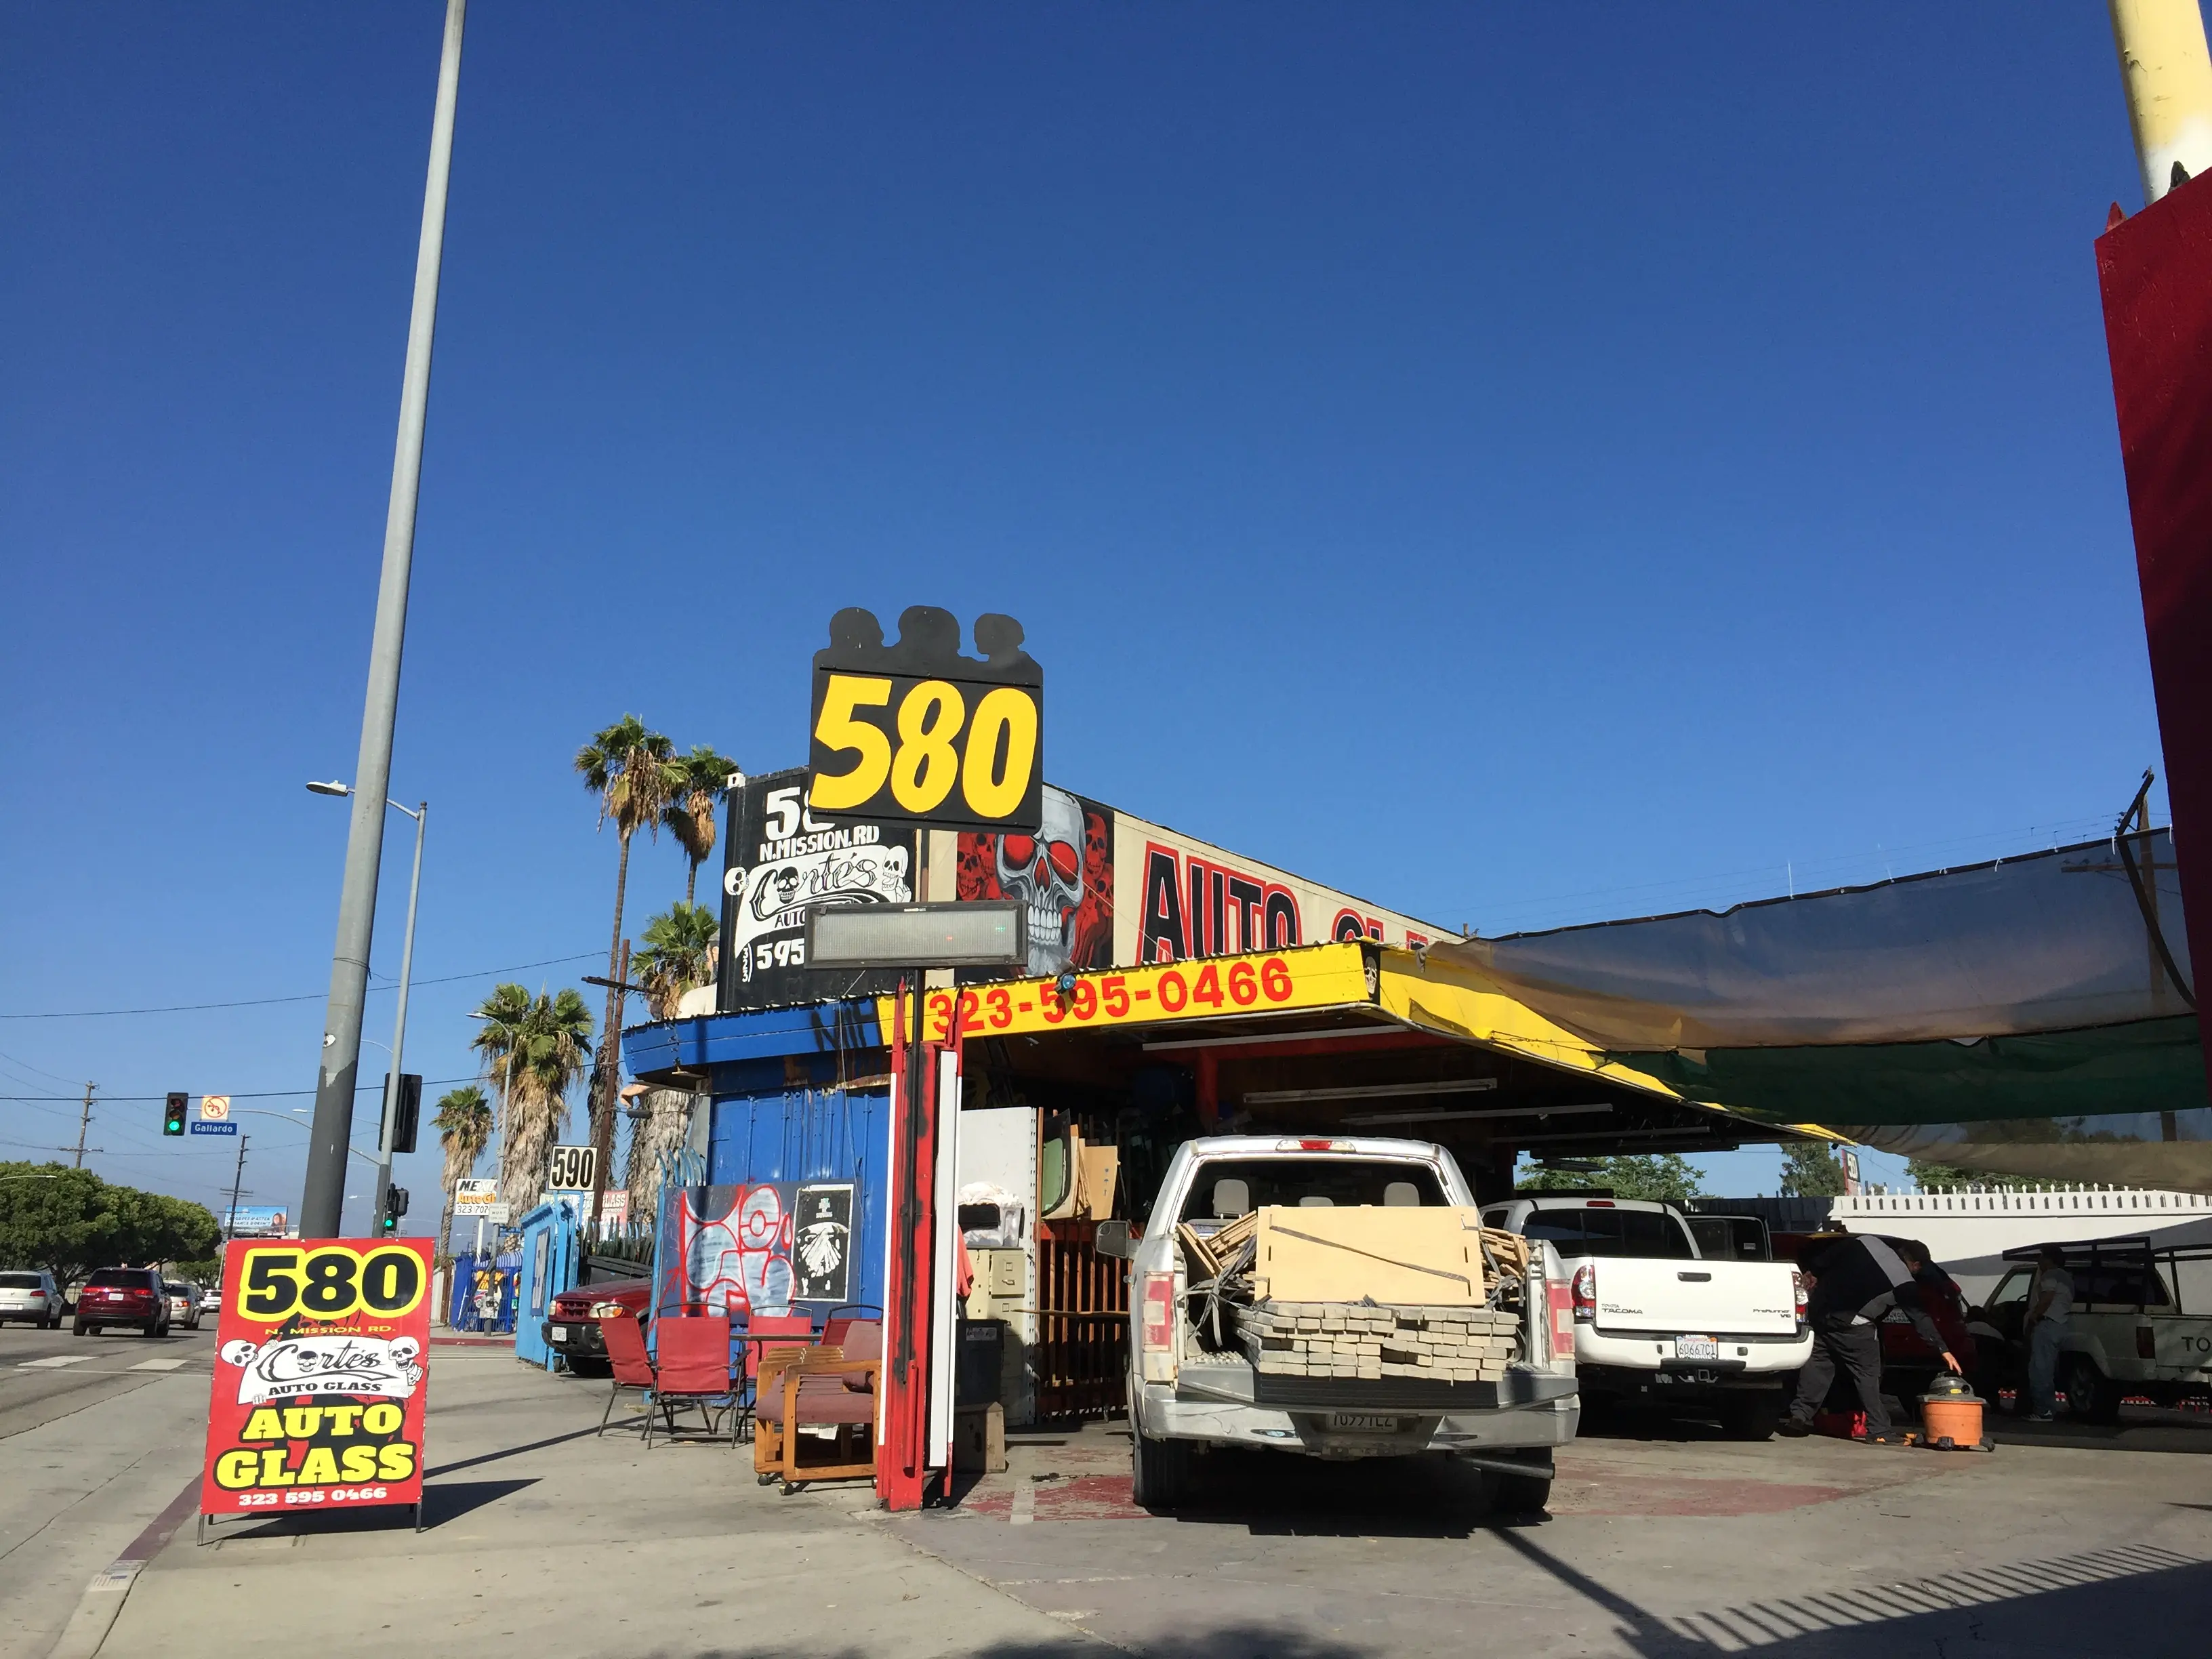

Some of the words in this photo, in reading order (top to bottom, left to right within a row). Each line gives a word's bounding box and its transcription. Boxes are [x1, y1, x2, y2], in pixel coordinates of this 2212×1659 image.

[808, 674, 1037, 817] 580
[929, 958, 1292, 1034] 323-595-0466
[194, 1124, 233, 1133] Gallardo
[552, 1149, 594, 1187] 590
[457, 1193, 482, 1204] Auto
[457, 1206, 472, 1214] 323
[244, 1251, 420, 1317] 580
[265, 1326, 283, 1336] N.
[290, 1326, 362, 1335] MISSION
[268, 1383, 318, 1396] AUTO
[323, 1381, 383, 1393] GLASS
[243, 1404, 403, 1440] AUTO
[216, 1443, 414, 1489] GLASS
[239, 1493, 278, 1506] 323
[285, 1490, 325, 1504] 595
[331, 1488, 388, 1501] 0466
